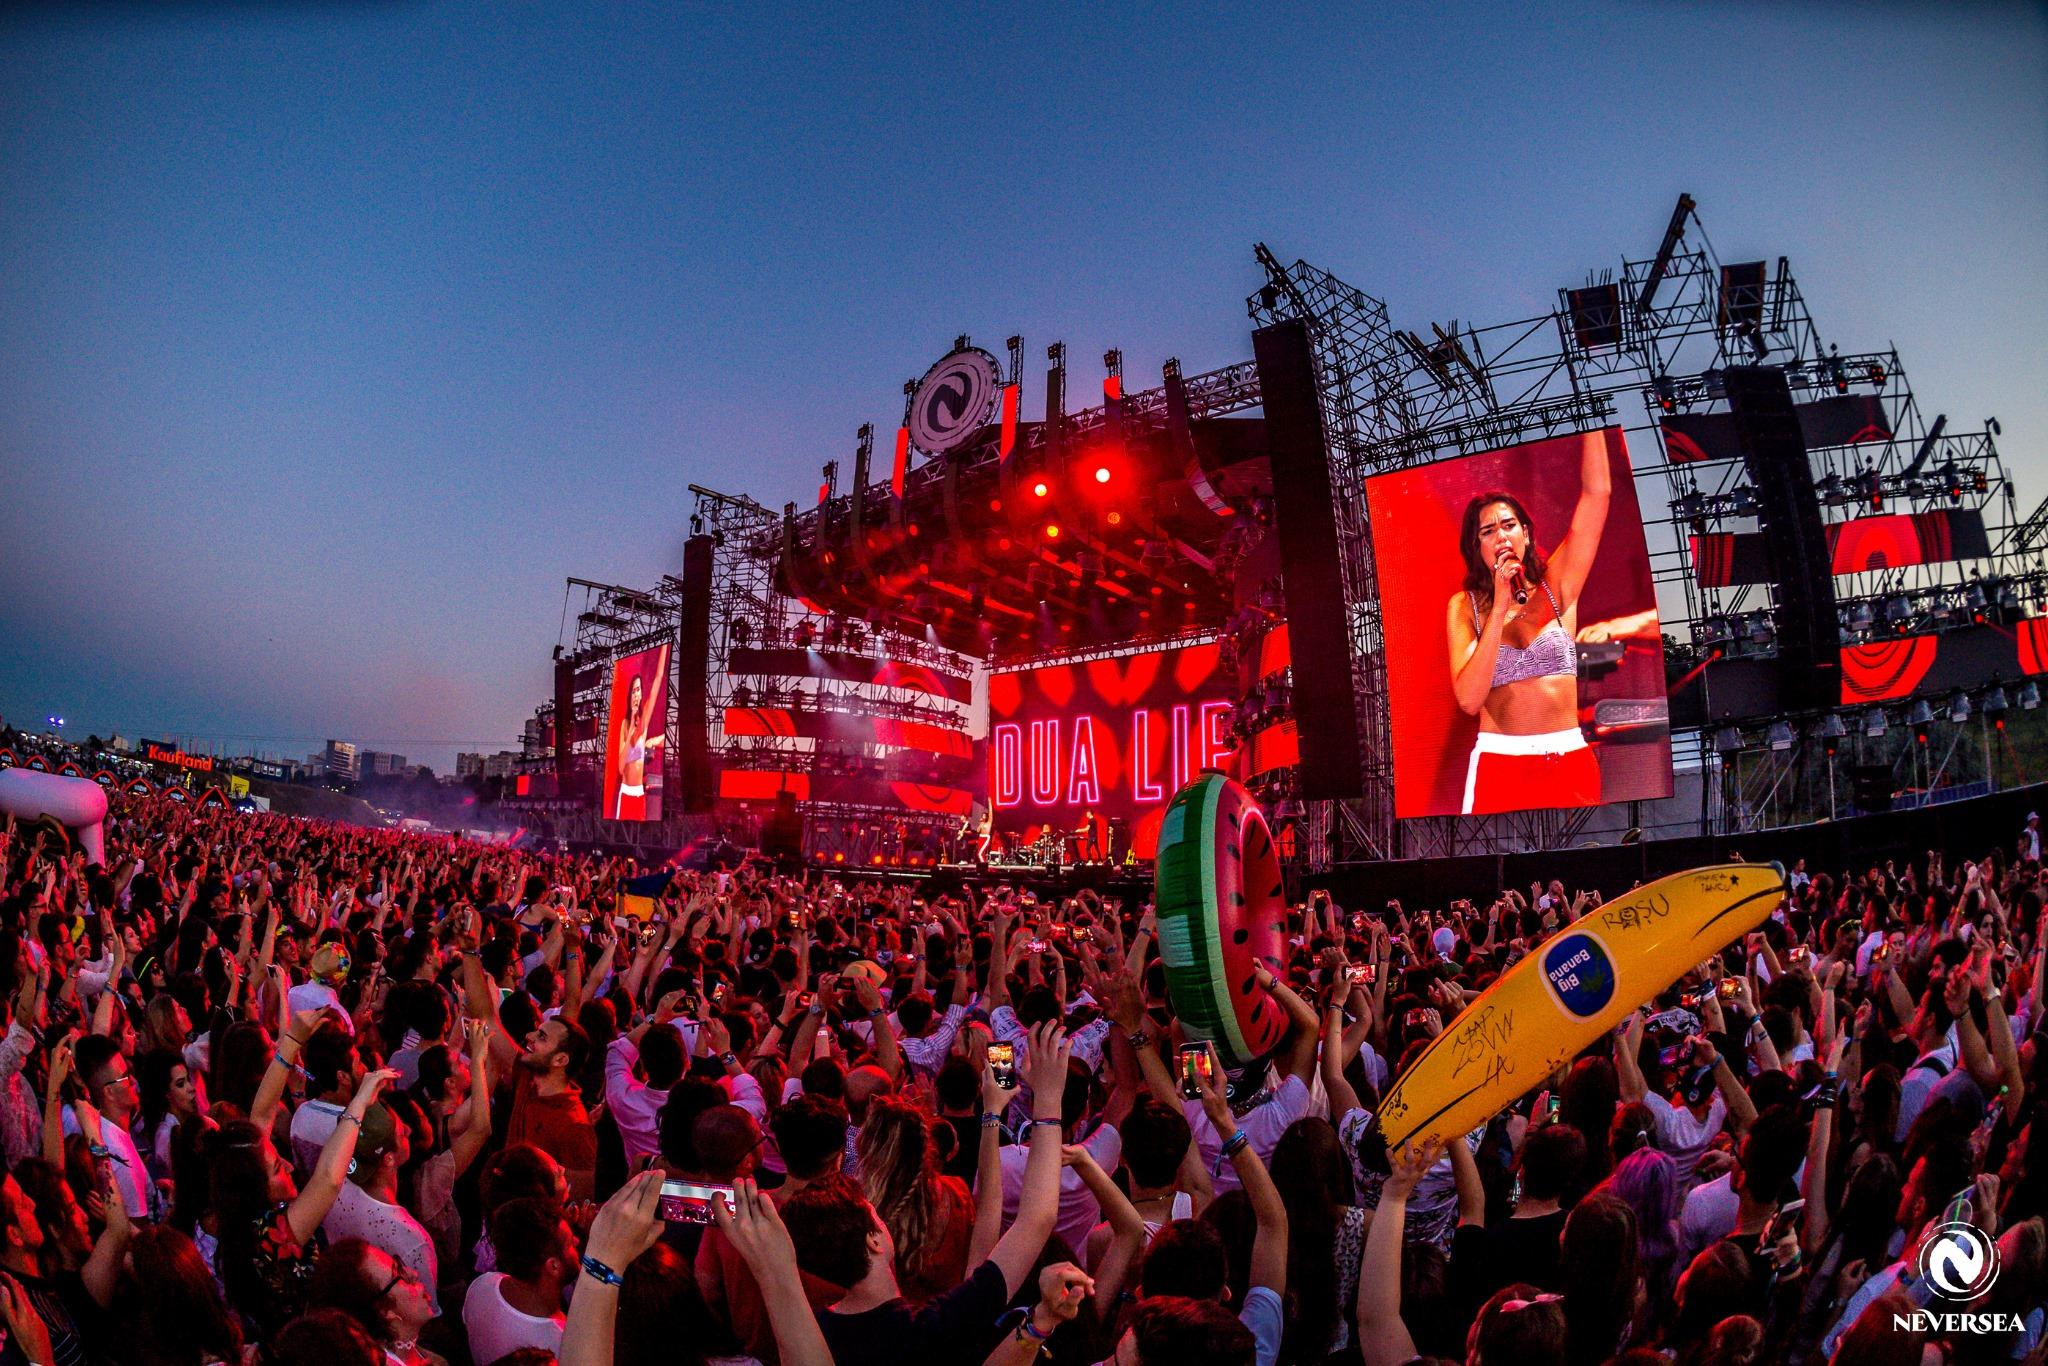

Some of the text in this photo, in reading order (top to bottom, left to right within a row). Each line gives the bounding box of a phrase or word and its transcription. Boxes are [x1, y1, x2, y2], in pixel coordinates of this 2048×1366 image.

[148, 744, 213, 772] Kaufland
[995, 715, 1100, 806] DUA
[1548, 949, 1591, 982] Banana
[1557, 973, 1580, 993] Big
